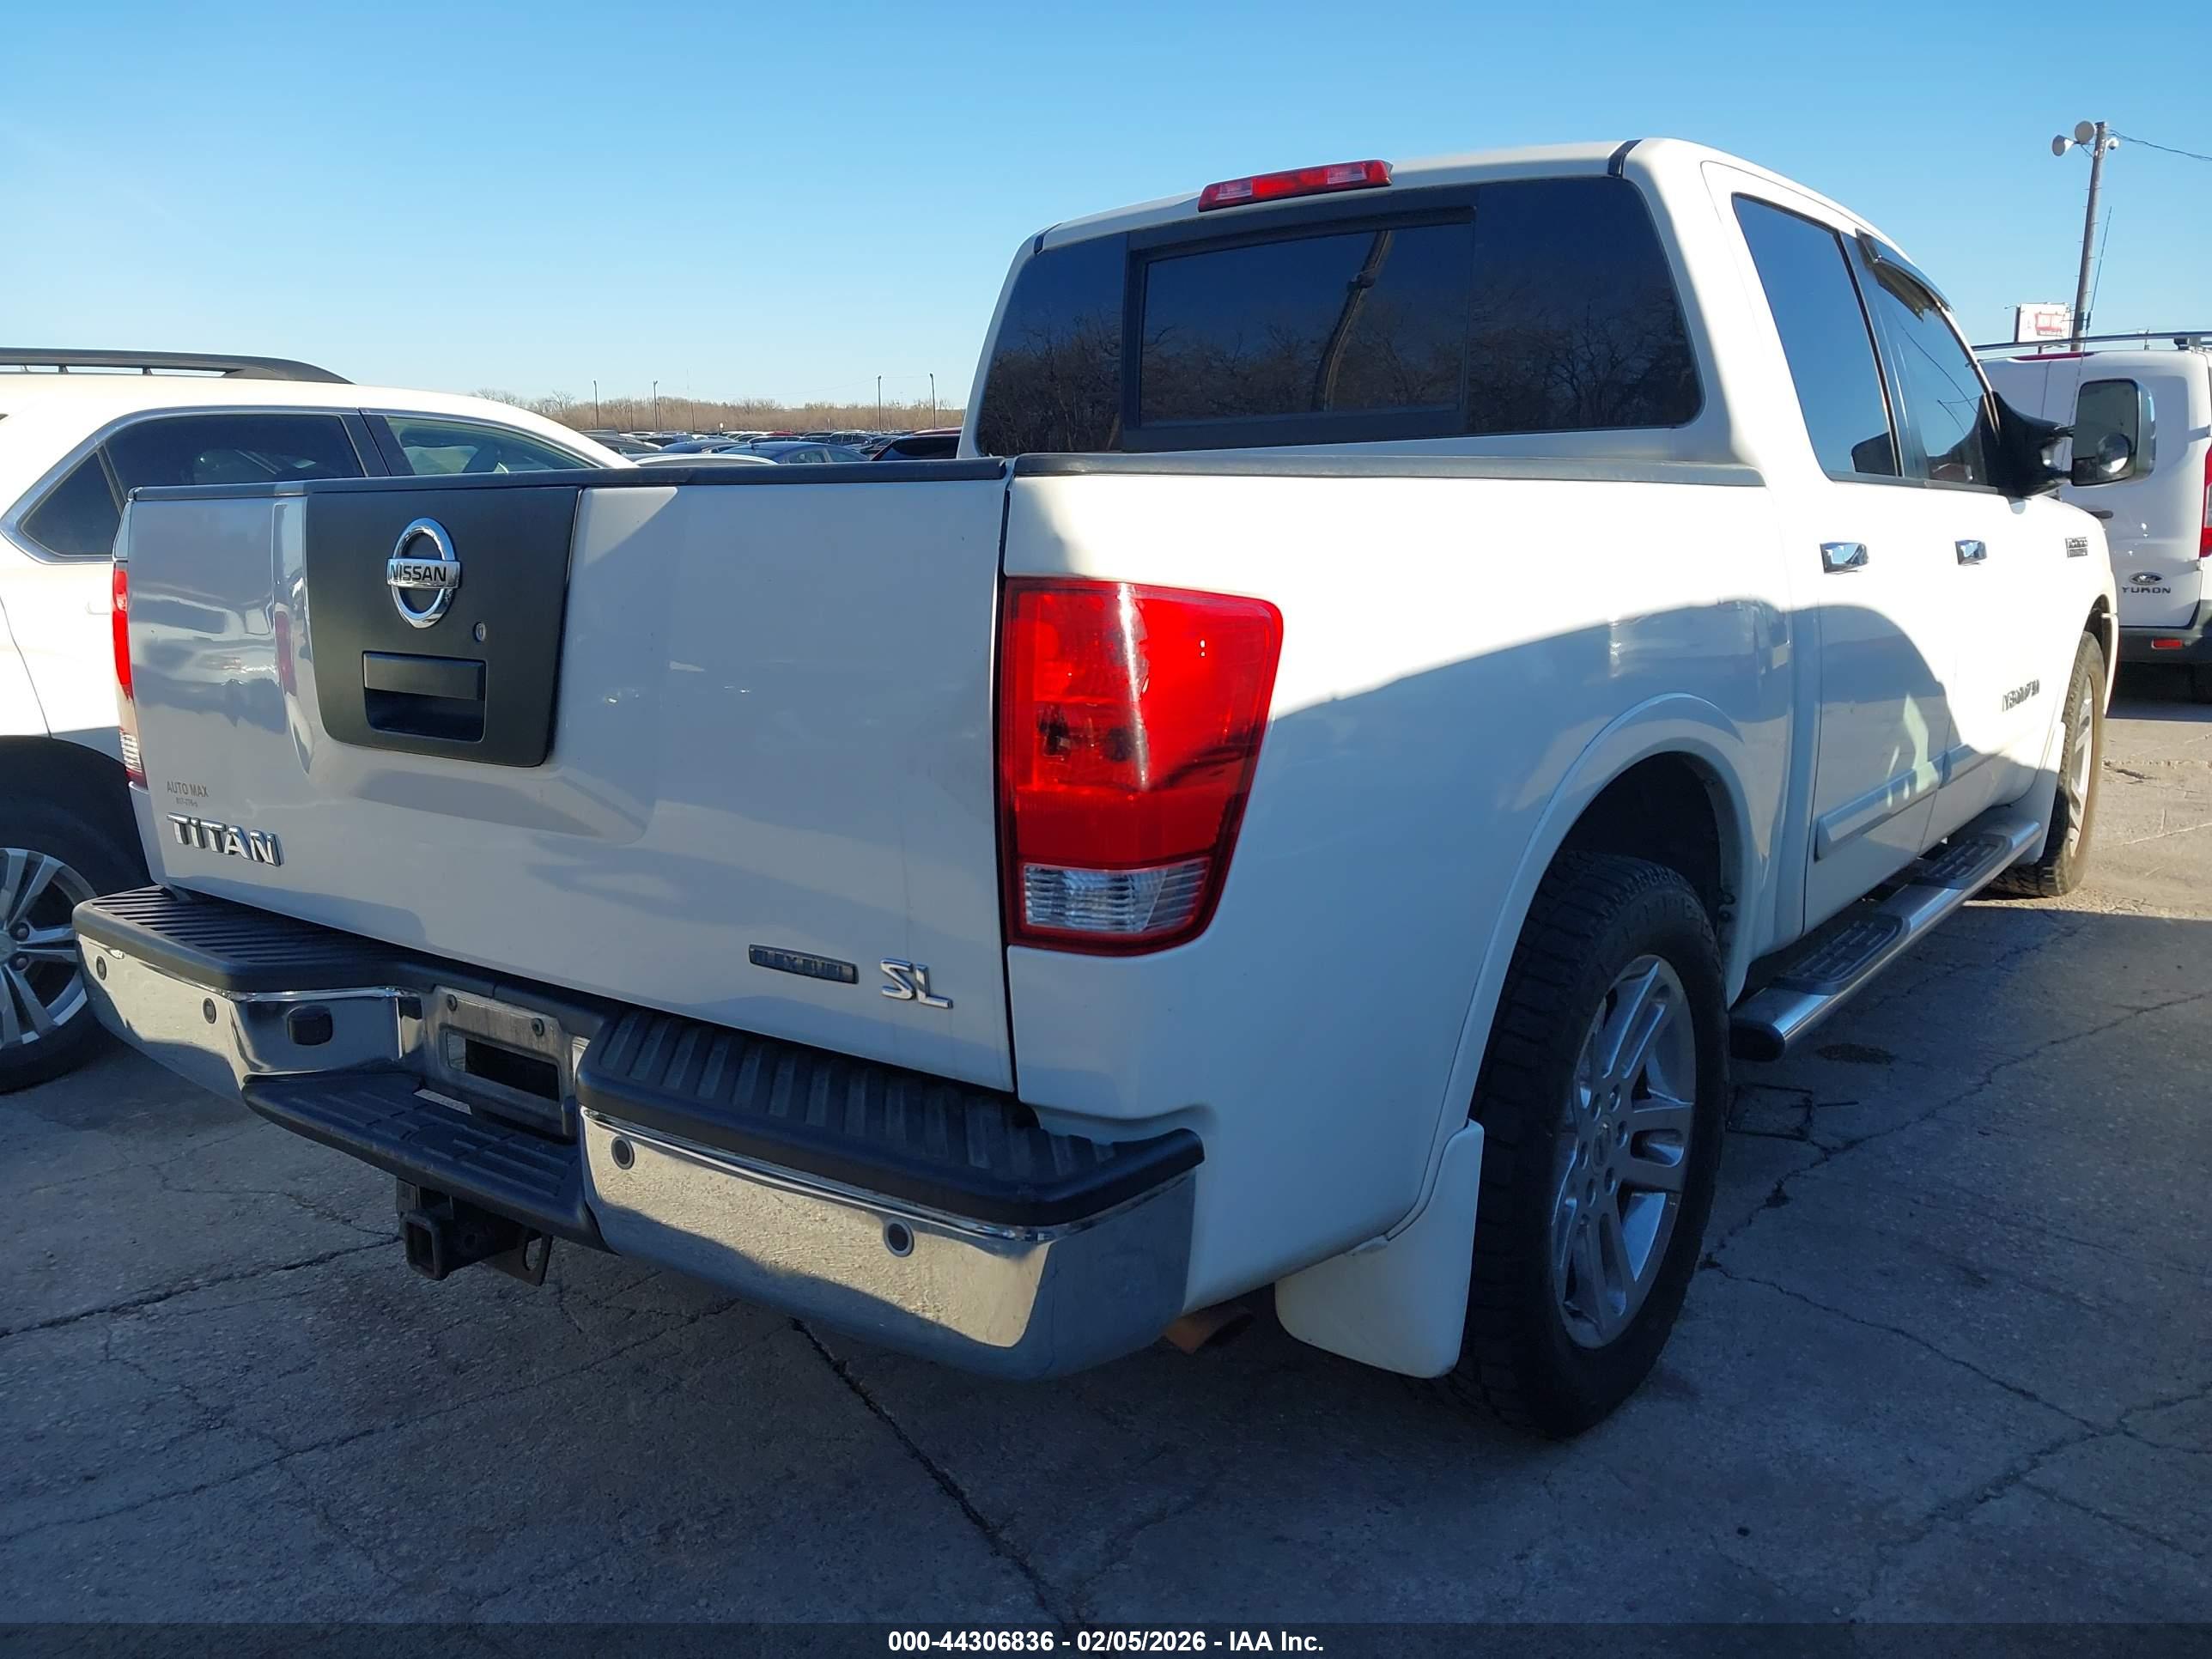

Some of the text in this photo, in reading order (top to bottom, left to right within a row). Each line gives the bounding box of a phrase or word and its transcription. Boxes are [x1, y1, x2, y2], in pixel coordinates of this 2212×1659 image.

[389, 563, 447, 582] NISSAN
[167, 781, 209, 797] AUTO MAX
[167, 812, 283, 866] TITAN
[880, 957, 953, 1009] SL
